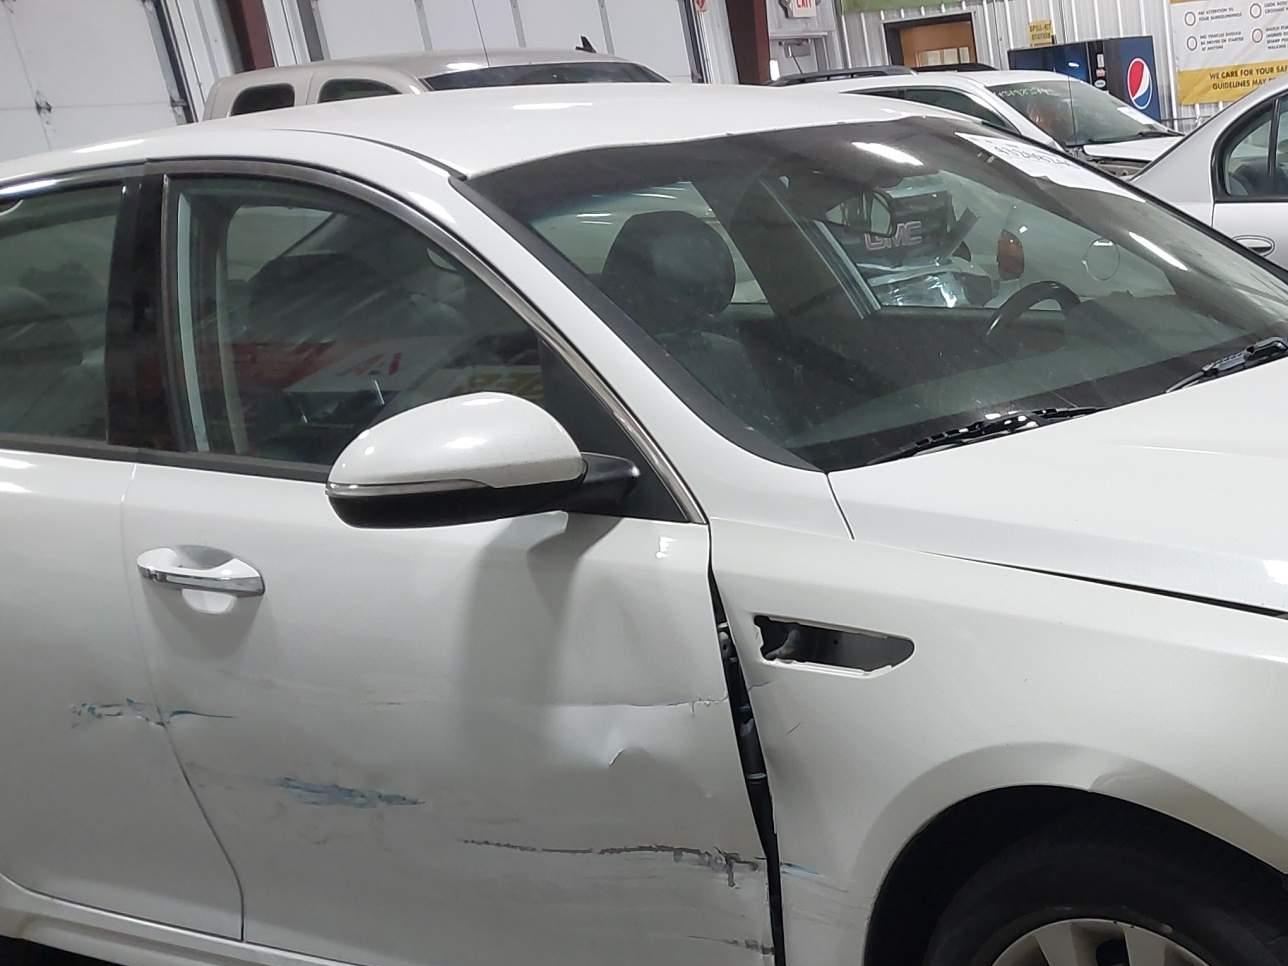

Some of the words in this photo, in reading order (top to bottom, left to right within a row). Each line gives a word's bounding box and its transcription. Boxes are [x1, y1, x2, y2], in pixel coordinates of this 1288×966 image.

[1209, 72, 1220, 80] WE
[1221, 70, 1239, 79] CARE
[1240, 69, 1253, 77] FOR
[1256, 67, 1274, 76] YOUR
[1212, 79, 1251, 90] GUIDELINES
